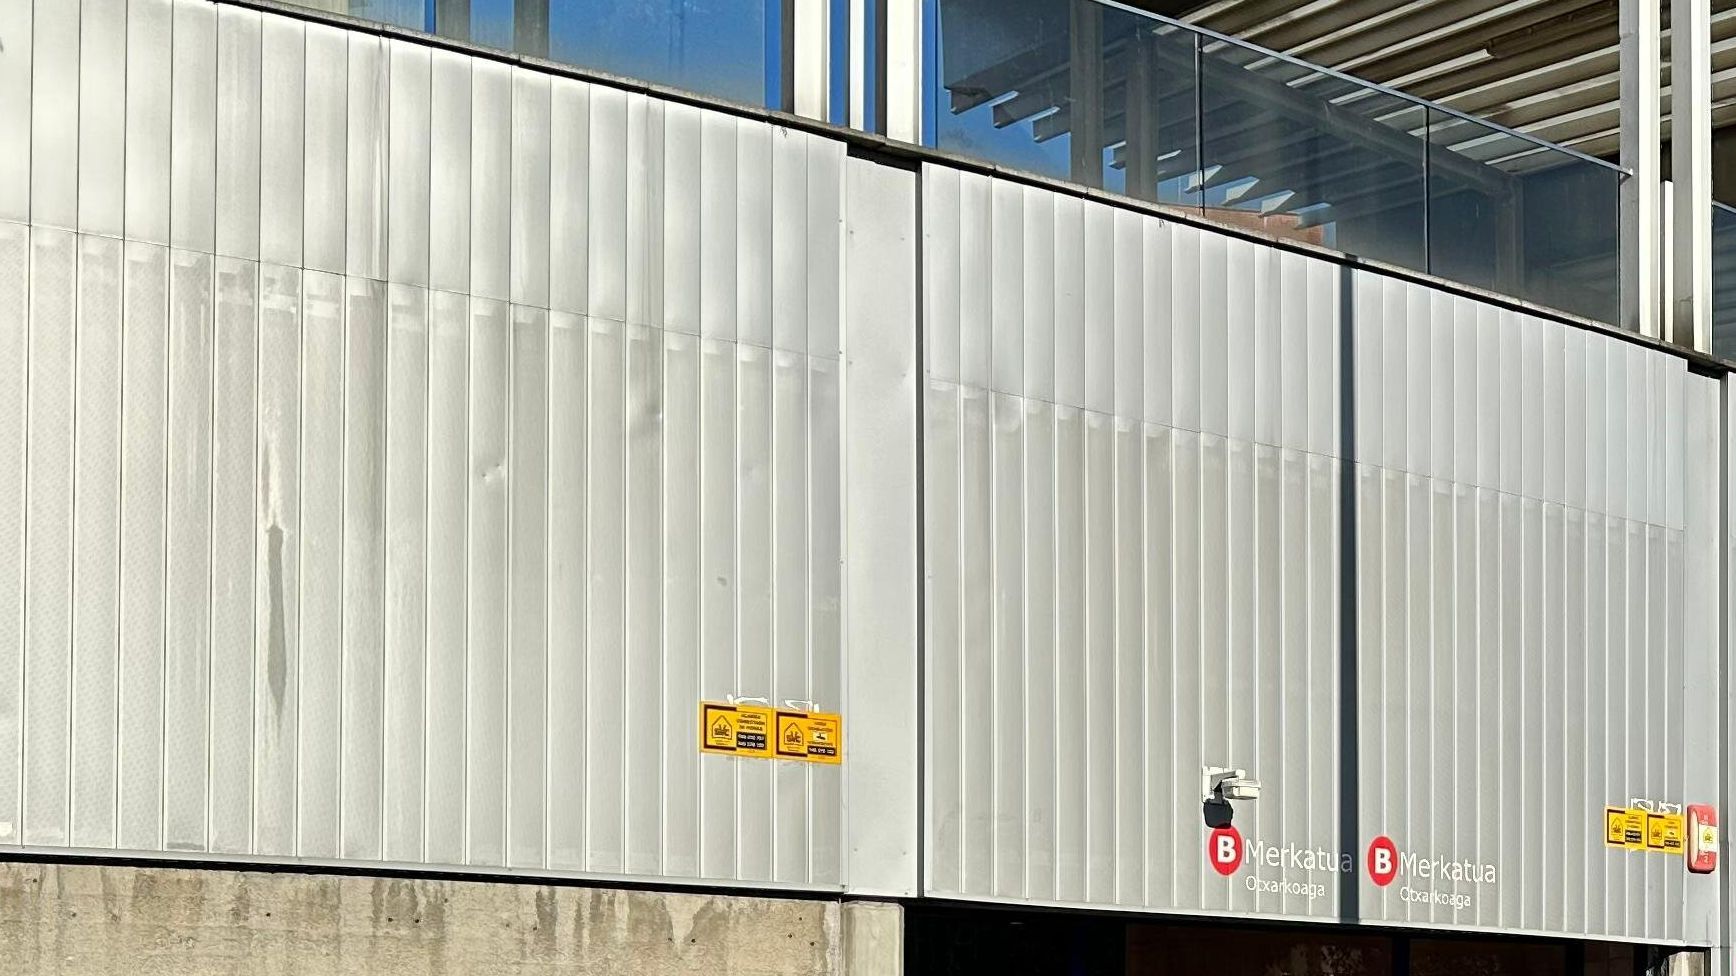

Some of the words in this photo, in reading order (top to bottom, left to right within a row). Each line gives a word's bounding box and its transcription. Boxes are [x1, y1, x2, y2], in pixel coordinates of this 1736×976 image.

[1217, 835, 1237, 863] B
[1245, 839, 1353, 873] Merkatua
[1374, 847, 1392, 875] B
[1400, 851, 1496, 884] Merkatua
[1245, 876, 1325, 900] Otxarkoaga
[1400, 886, 1471, 909] Otxarkoaga
